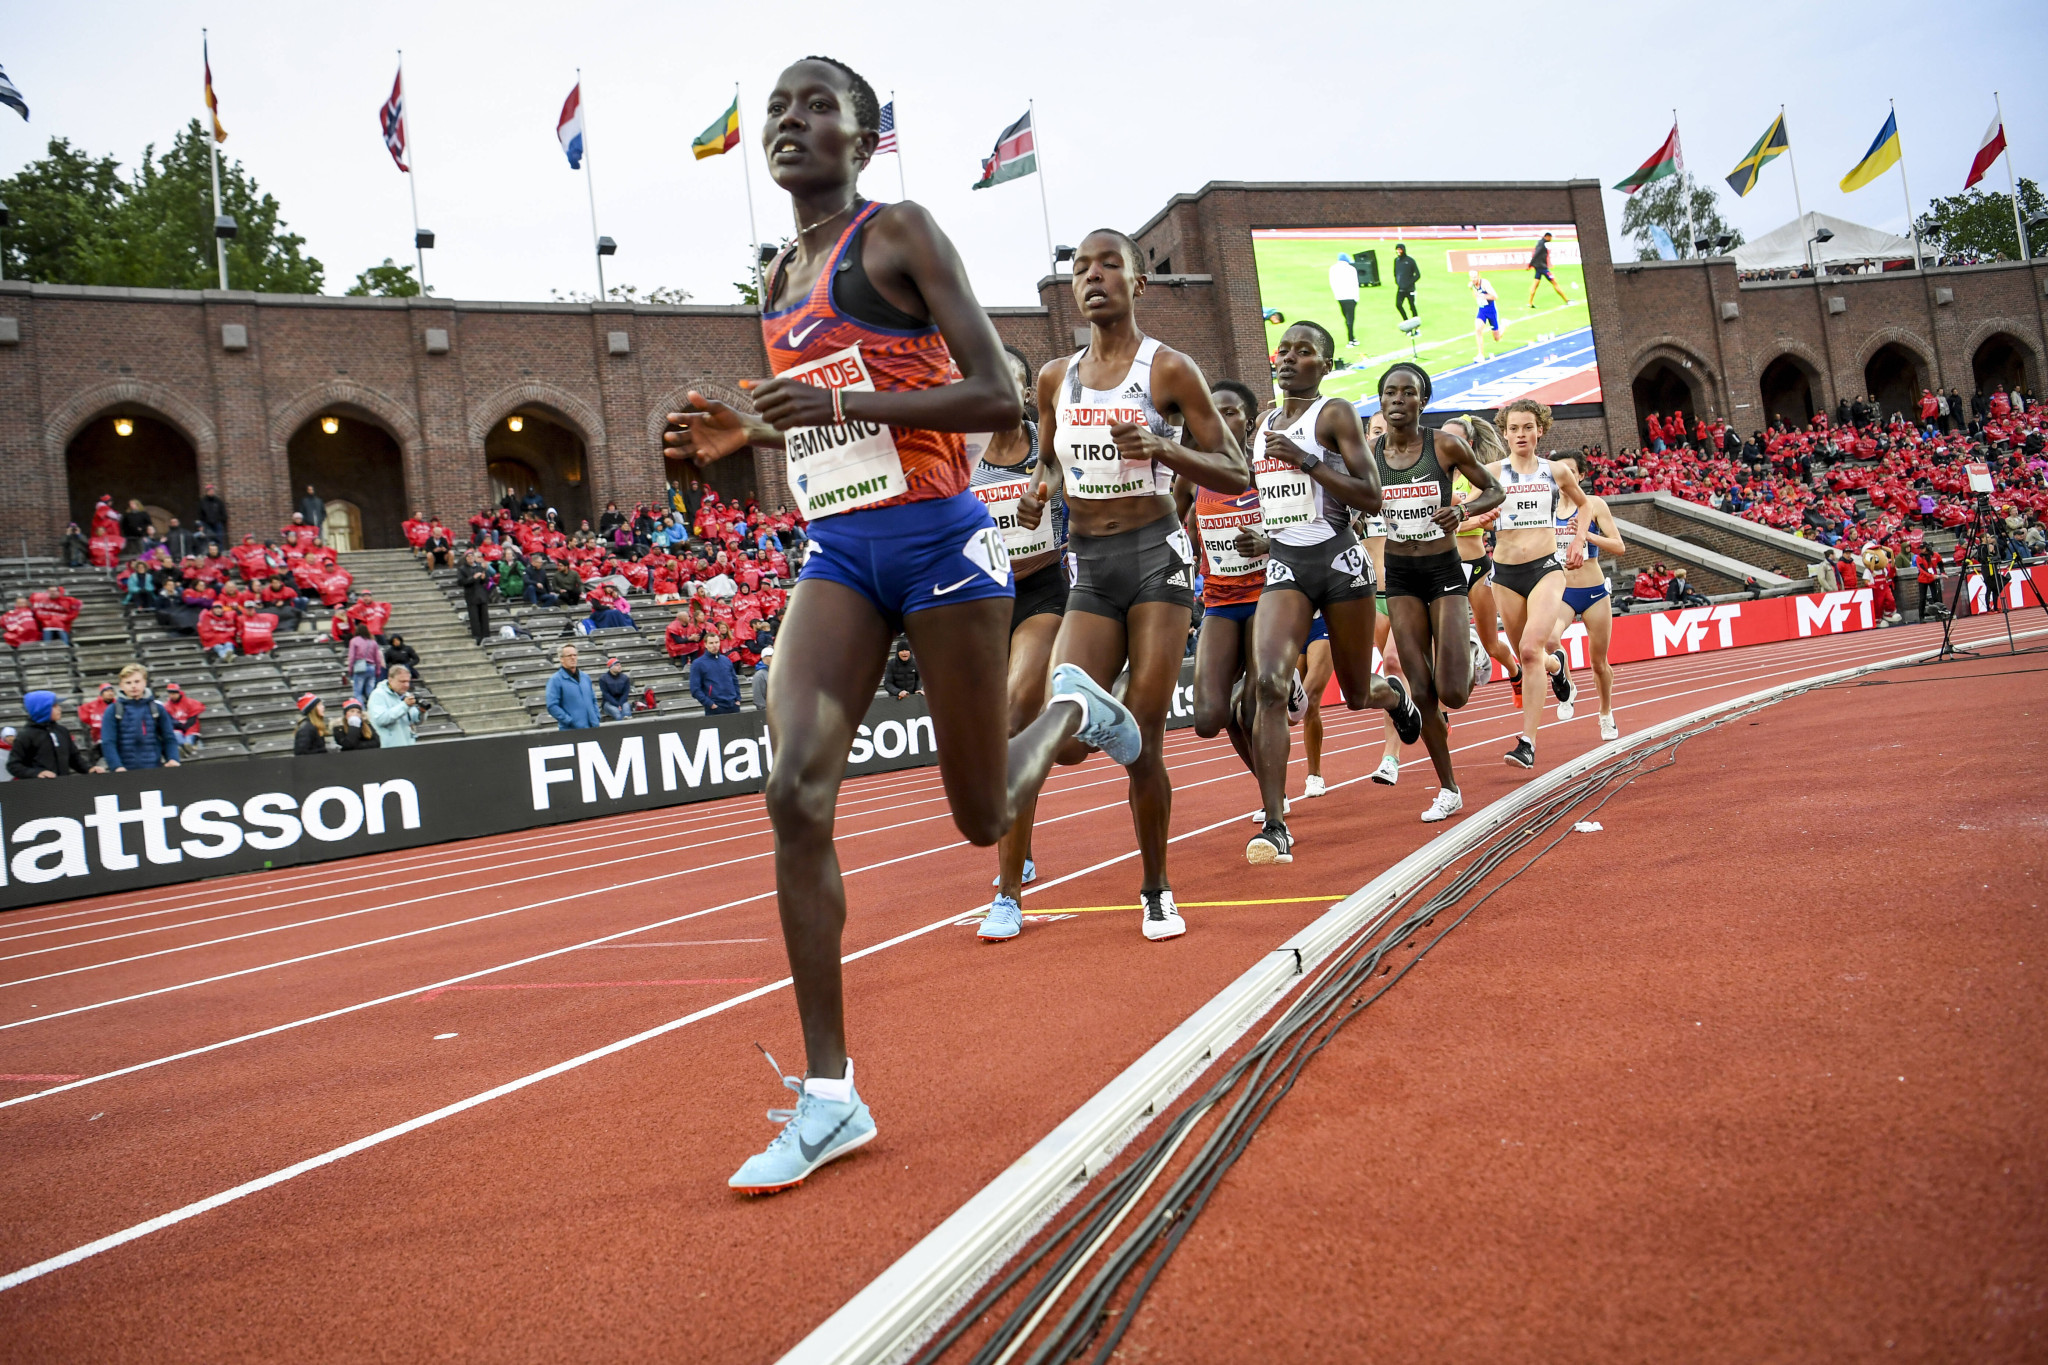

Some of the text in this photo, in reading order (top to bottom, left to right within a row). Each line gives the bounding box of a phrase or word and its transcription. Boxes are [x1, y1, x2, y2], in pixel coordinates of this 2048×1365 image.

[1071, 444, 1121, 461] TIRO
[809, 475, 888, 510] HUNTONIT
[1079, 479, 1144, 493] HUNTONIT
[1384, 485, 1437, 500] AUHAUS
[1517, 501, 1538, 510] REH
[1201, 511, 1260, 529] BAUHAUS
[1266, 514, 1308, 525] UNTONIT
[1396, 530, 1437, 540] HUNTONIT
[980, 530, 1007, 570] 16
[1008, 541, 1047, 556] NTONIT
[1220, 559, 1263, 572] HUNTONIT
[1340, 548, 1361, 571] 13
[1796, 588, 1874, 637] MFT
[1651, 604, 1741, 657] MFT
[528, 736, 648, 811] FM
